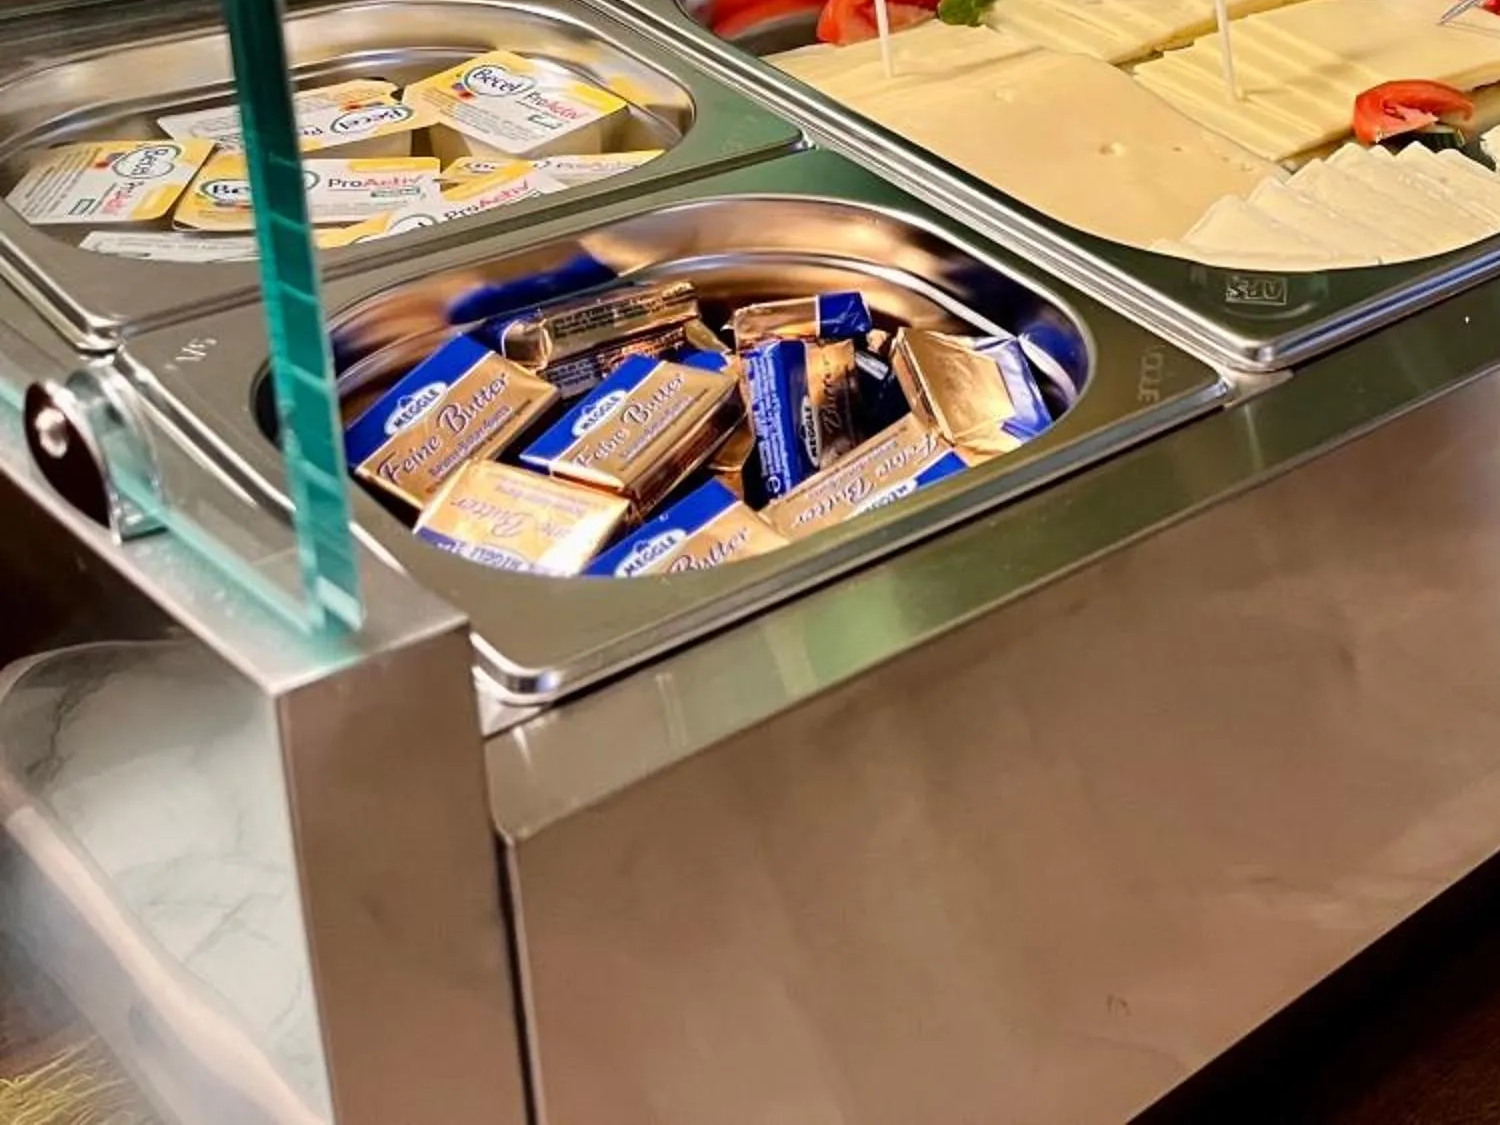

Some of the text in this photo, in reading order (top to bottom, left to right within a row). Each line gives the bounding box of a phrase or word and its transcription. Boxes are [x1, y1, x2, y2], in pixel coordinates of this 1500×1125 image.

[472, 67, 522, 92] Becel
[327, 175, 427, 188] ProActiv
[393, 387, 442, 428] MEGGLE
[622, 371, 686, 425] Butter
[377, 435, 442, 483] Feine
[437, 371, 511, 436] Butter
[791, 474, 876, 528] Butter
[623, 535, 677, 575] MEGGLE
